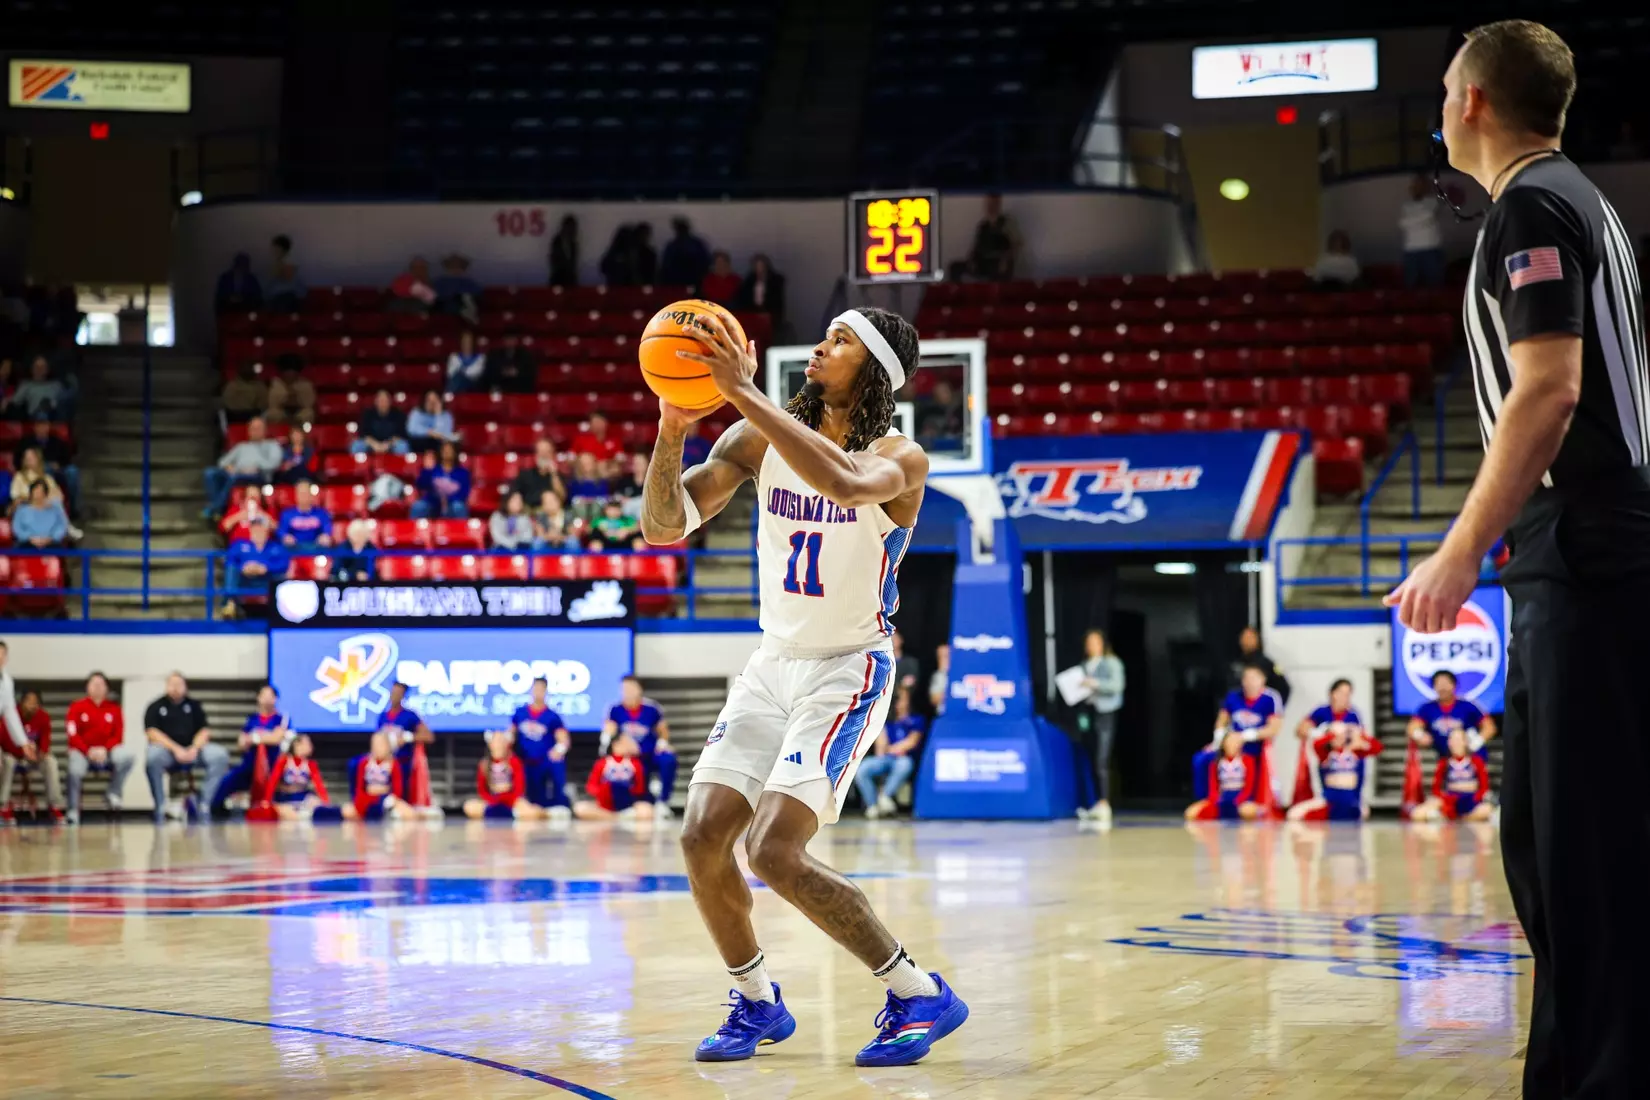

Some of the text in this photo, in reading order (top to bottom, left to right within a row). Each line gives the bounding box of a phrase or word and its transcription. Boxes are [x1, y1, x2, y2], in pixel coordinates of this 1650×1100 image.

[491, 209, 546, 237] 105
[866, 225, 923, 273] 22
[658, 311, 716, 335] Wilso
[767, 485, 825, 522] LOUISINA
[783, 530, 824, 597] 11
[1411, 642, 1493, 660] PEPSI
